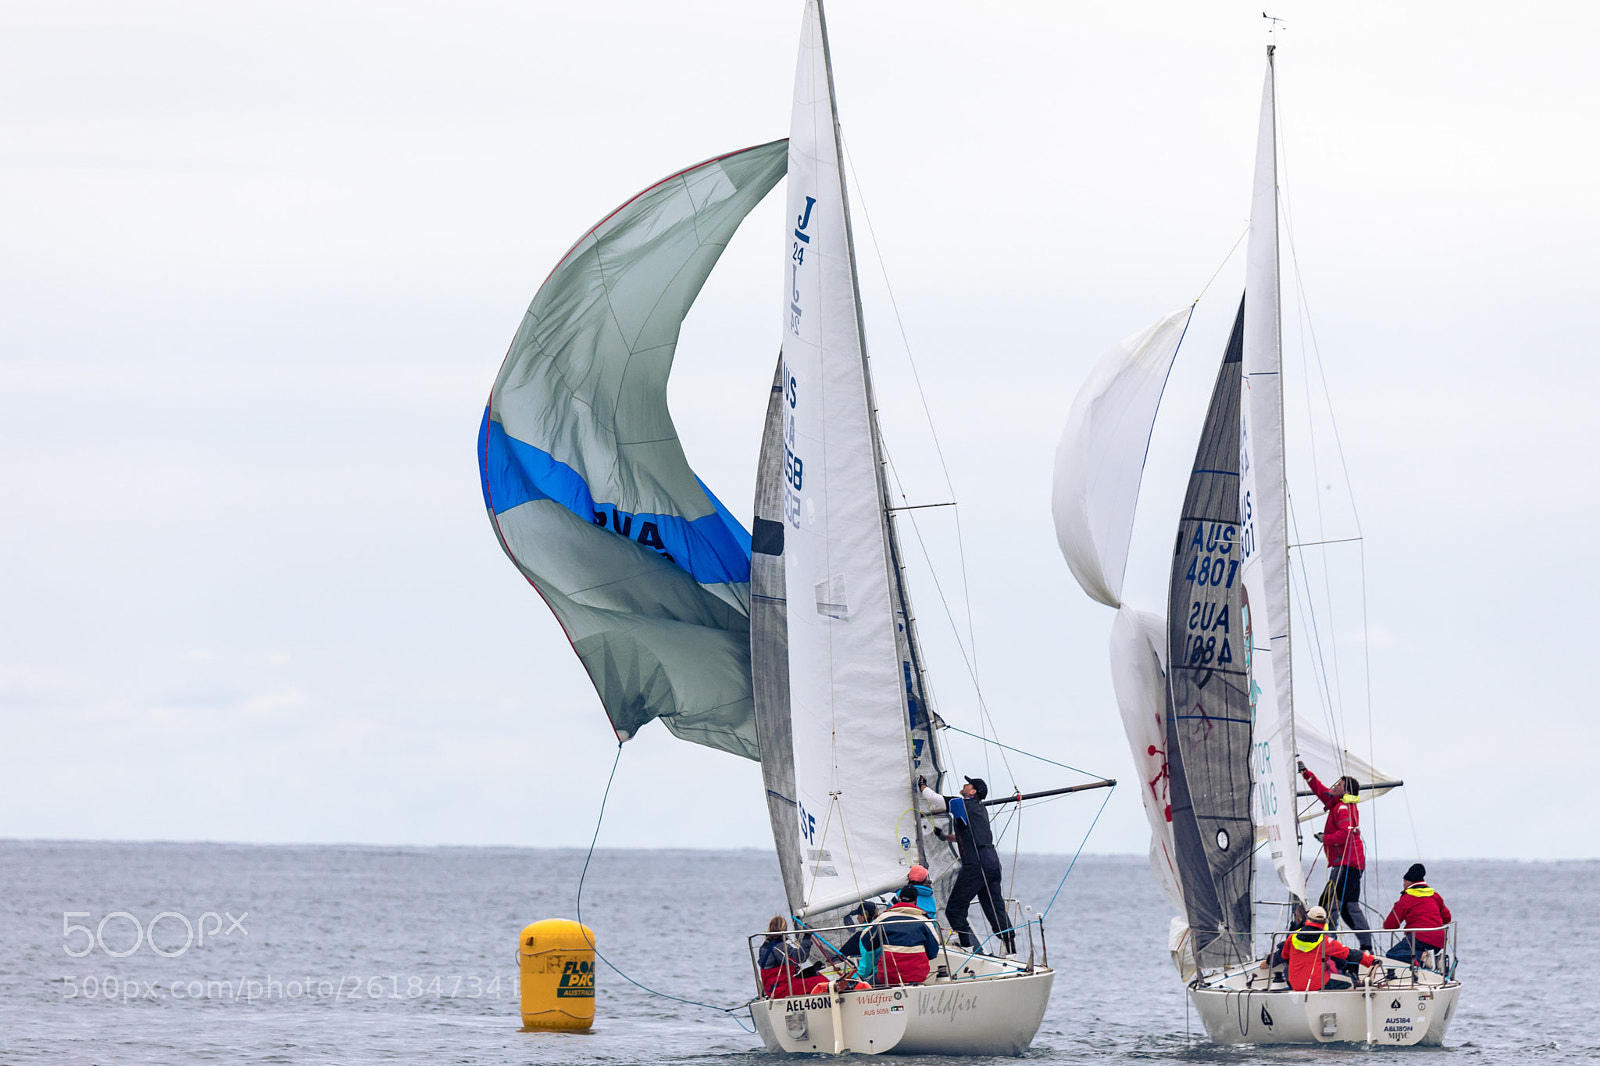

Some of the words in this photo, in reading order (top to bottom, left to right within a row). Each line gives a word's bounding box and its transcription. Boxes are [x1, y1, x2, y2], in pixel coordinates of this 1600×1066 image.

[792, 241, 804, 266] 24
[783, 361, 797, 409] US
[1190, 522, 1235, 554] AUS
[1186, 556, 1239, 588] 4801
[786, 997, 832, 1012] AEL460N
[857, 992, 893, 1006] Wildfire
